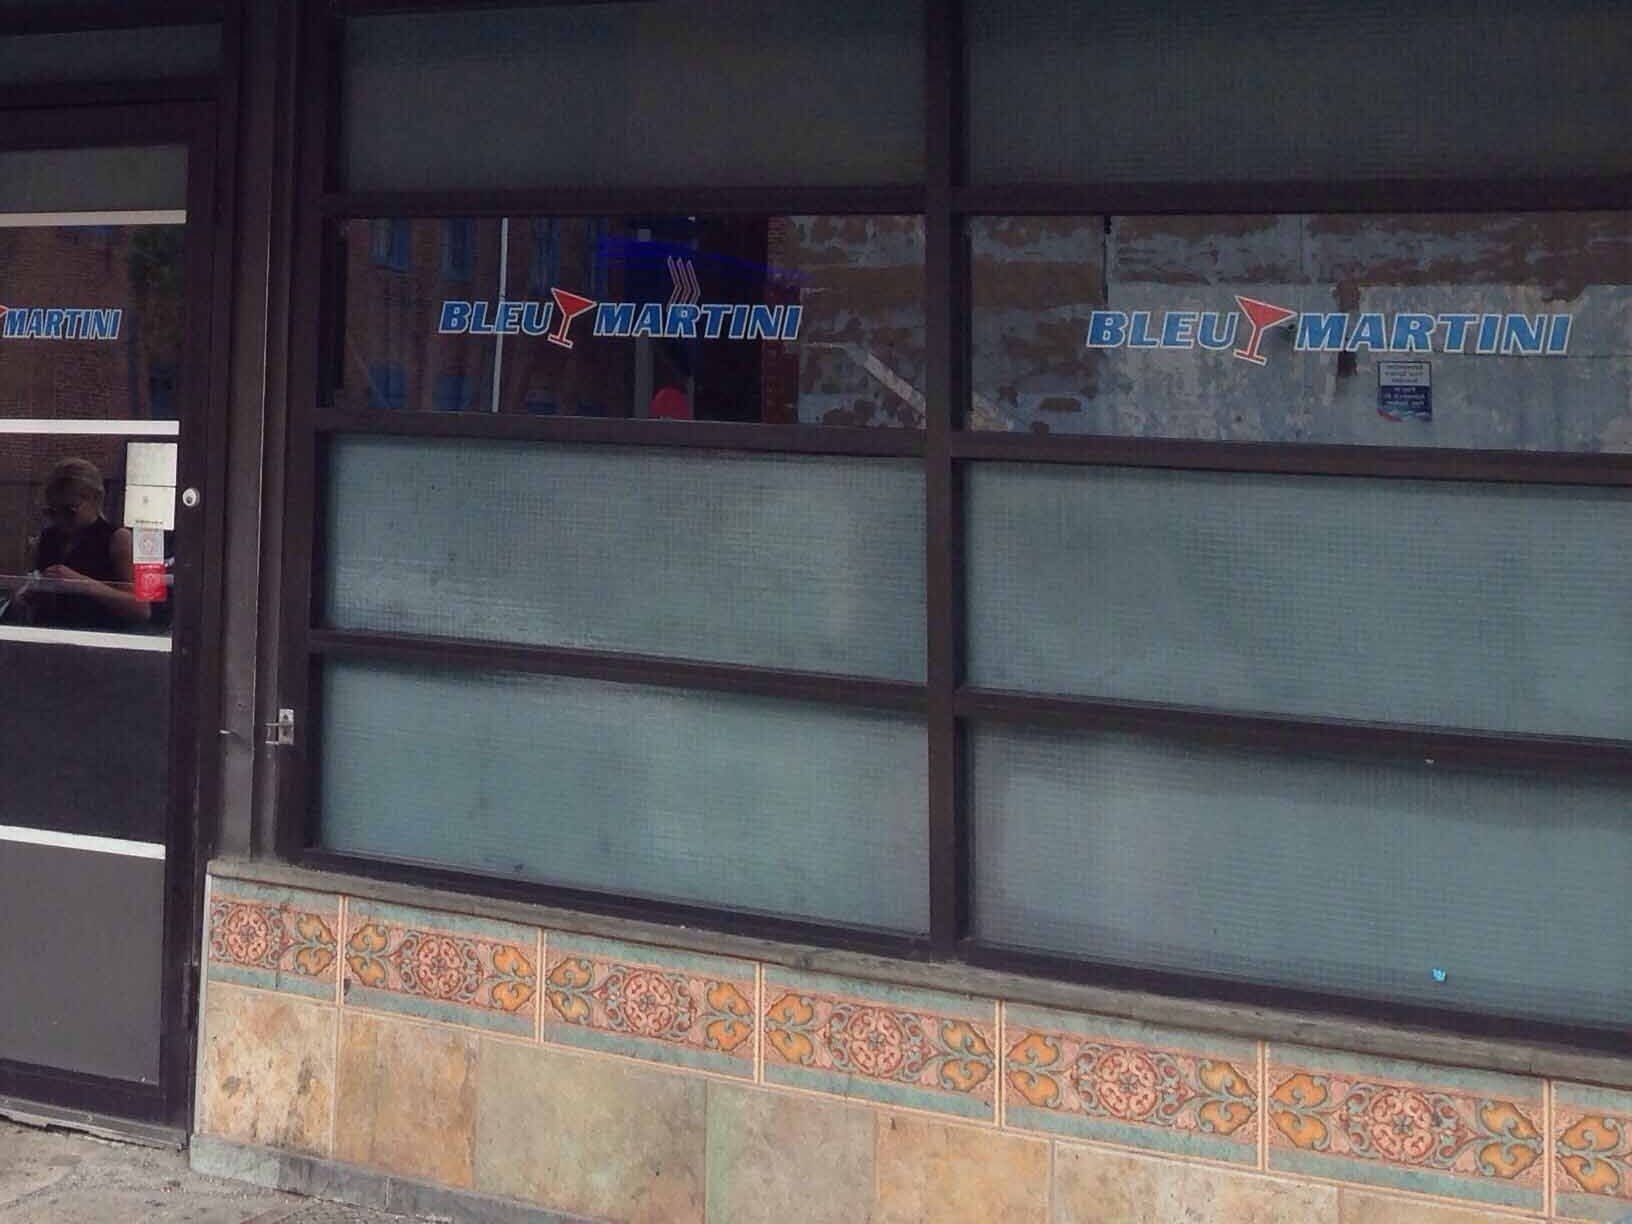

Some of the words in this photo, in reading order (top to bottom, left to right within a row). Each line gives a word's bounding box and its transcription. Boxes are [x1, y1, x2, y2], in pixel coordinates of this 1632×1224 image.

[2, 307, 122, 340] MARTINI
[438, 300, 553, 335] BLEU
[593, 302, 803, 340] MARTINI
[1086, 310, 1240, 349] BLEU
[1294, 312, 1574, 355] MARTINI
